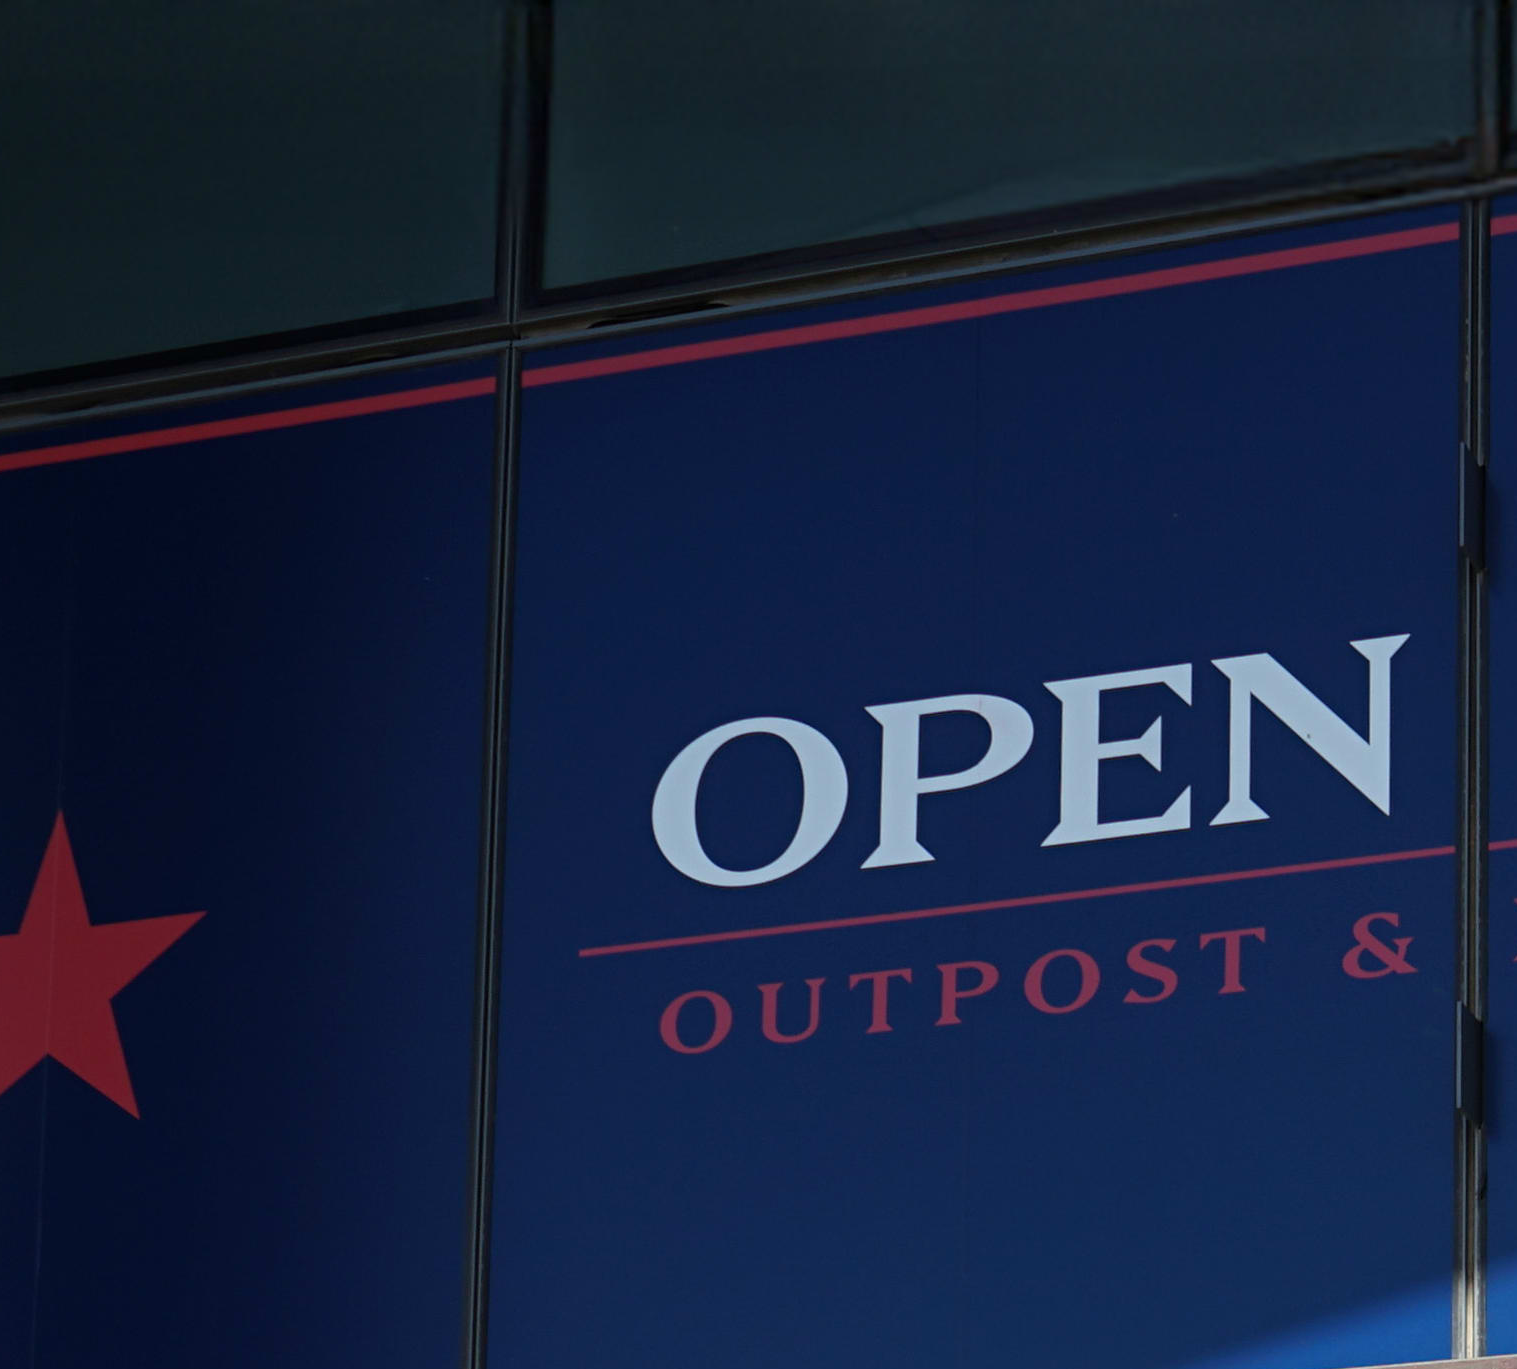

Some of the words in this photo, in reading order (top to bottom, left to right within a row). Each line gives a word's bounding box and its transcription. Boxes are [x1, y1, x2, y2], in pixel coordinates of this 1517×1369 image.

[651, 632, 1411, 888] OPEN
[659, 926, 1266, 1055] OUTPOST
[1342, 911, 1417, 981] &
